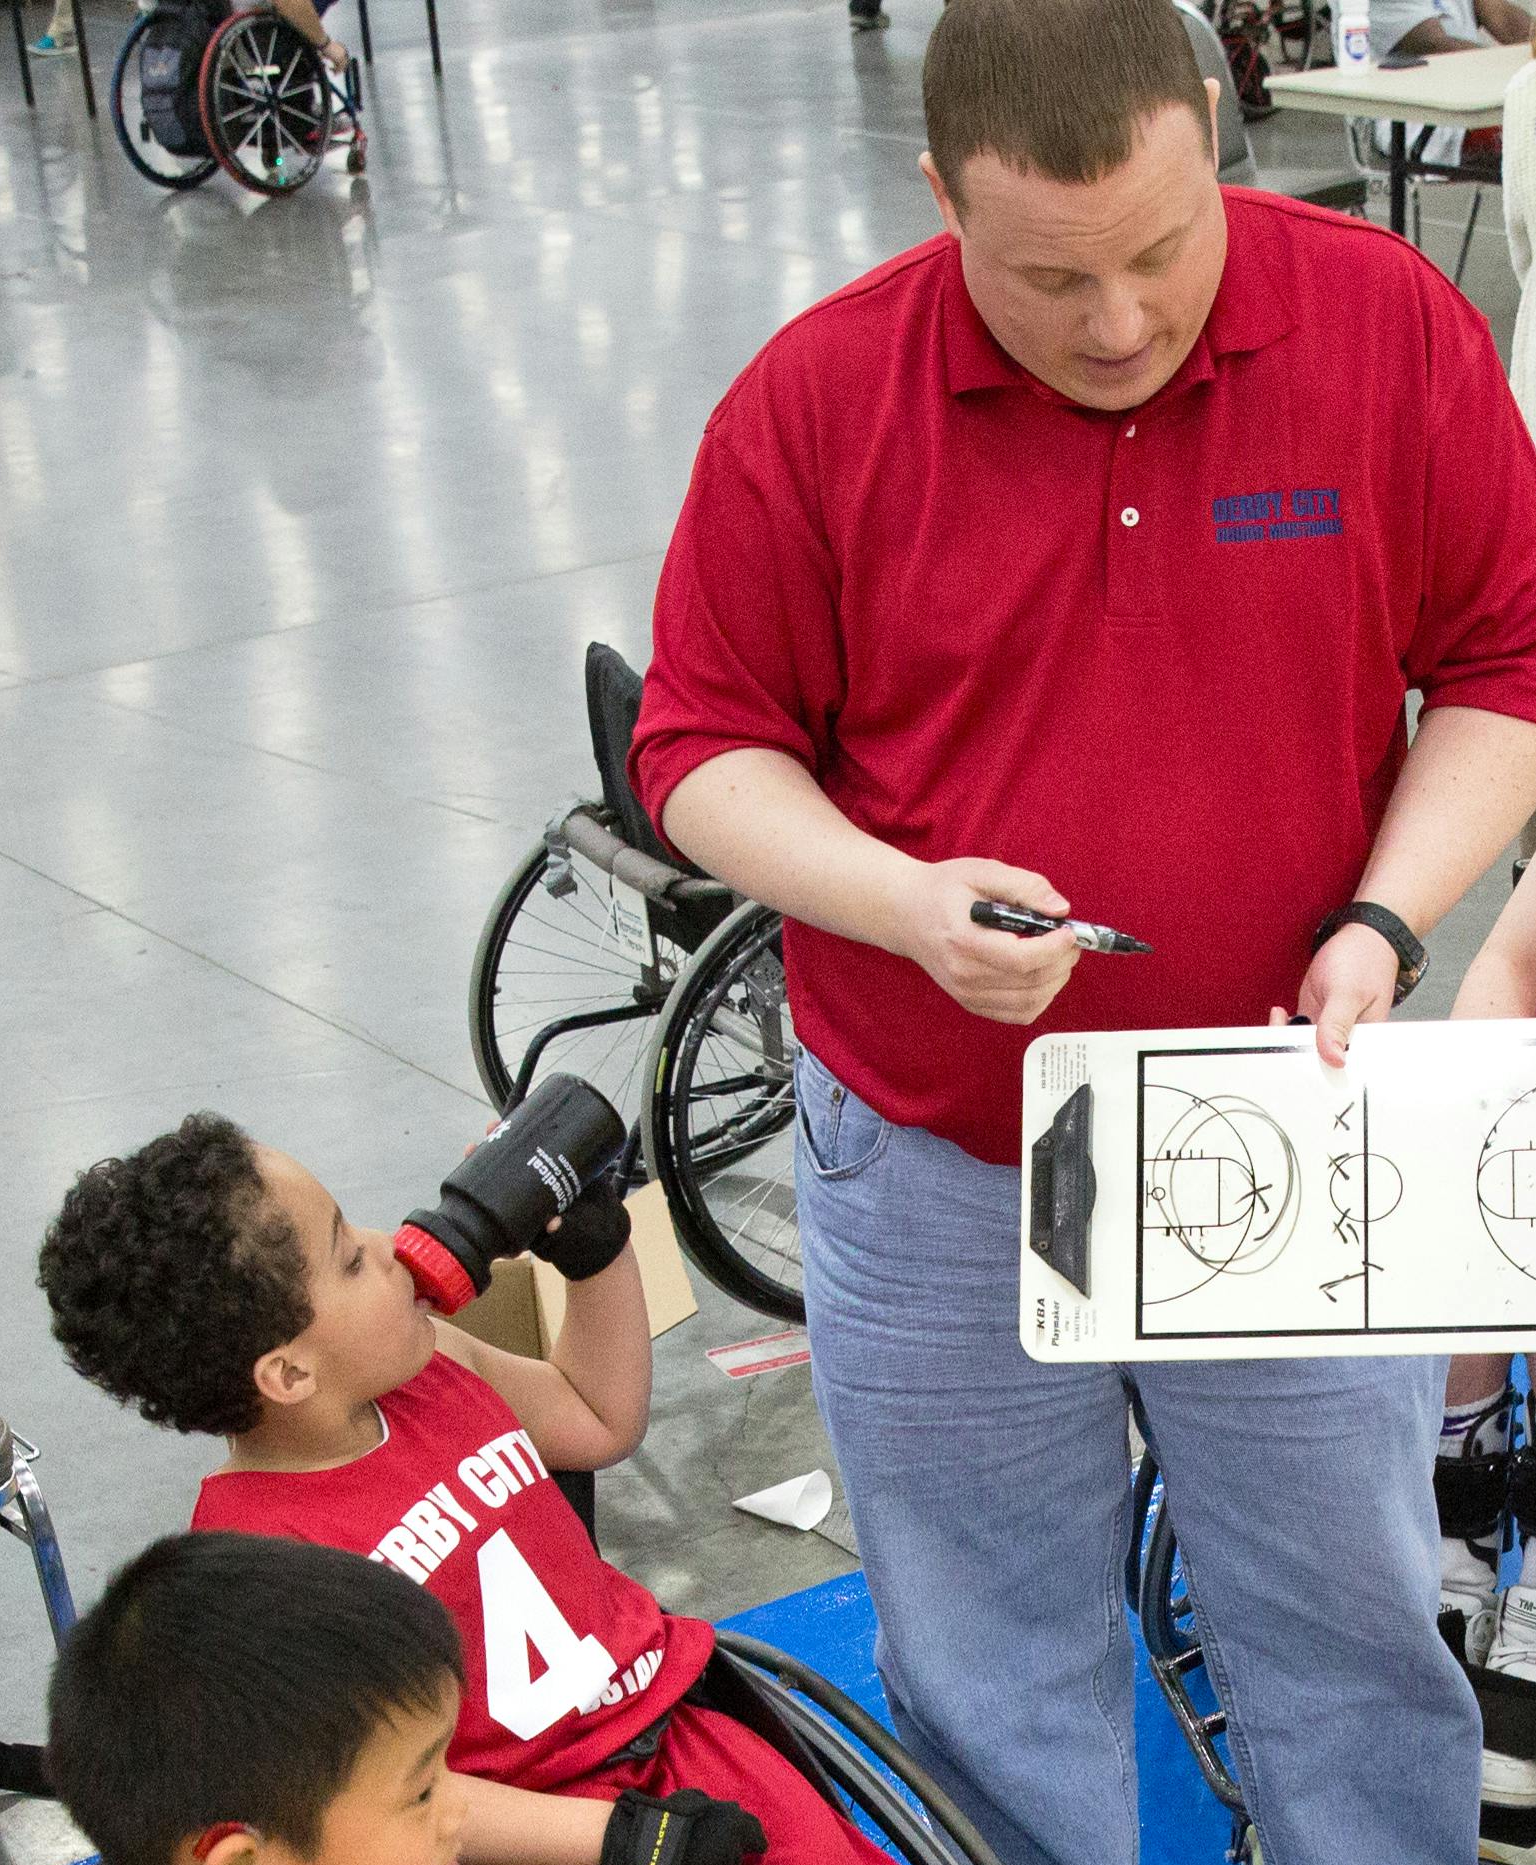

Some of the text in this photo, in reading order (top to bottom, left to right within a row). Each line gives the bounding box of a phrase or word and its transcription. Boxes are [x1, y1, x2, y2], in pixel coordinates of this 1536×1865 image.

[1213, 487, 1341, 524] DERBY CITY
[1036, 1298, 1046, 1330] KBA
[1051, 1300, 1061, 1347] Playmaker
[456, 1427, 550, 1510] CITY
[475, 1526, 619, 1743] 4
